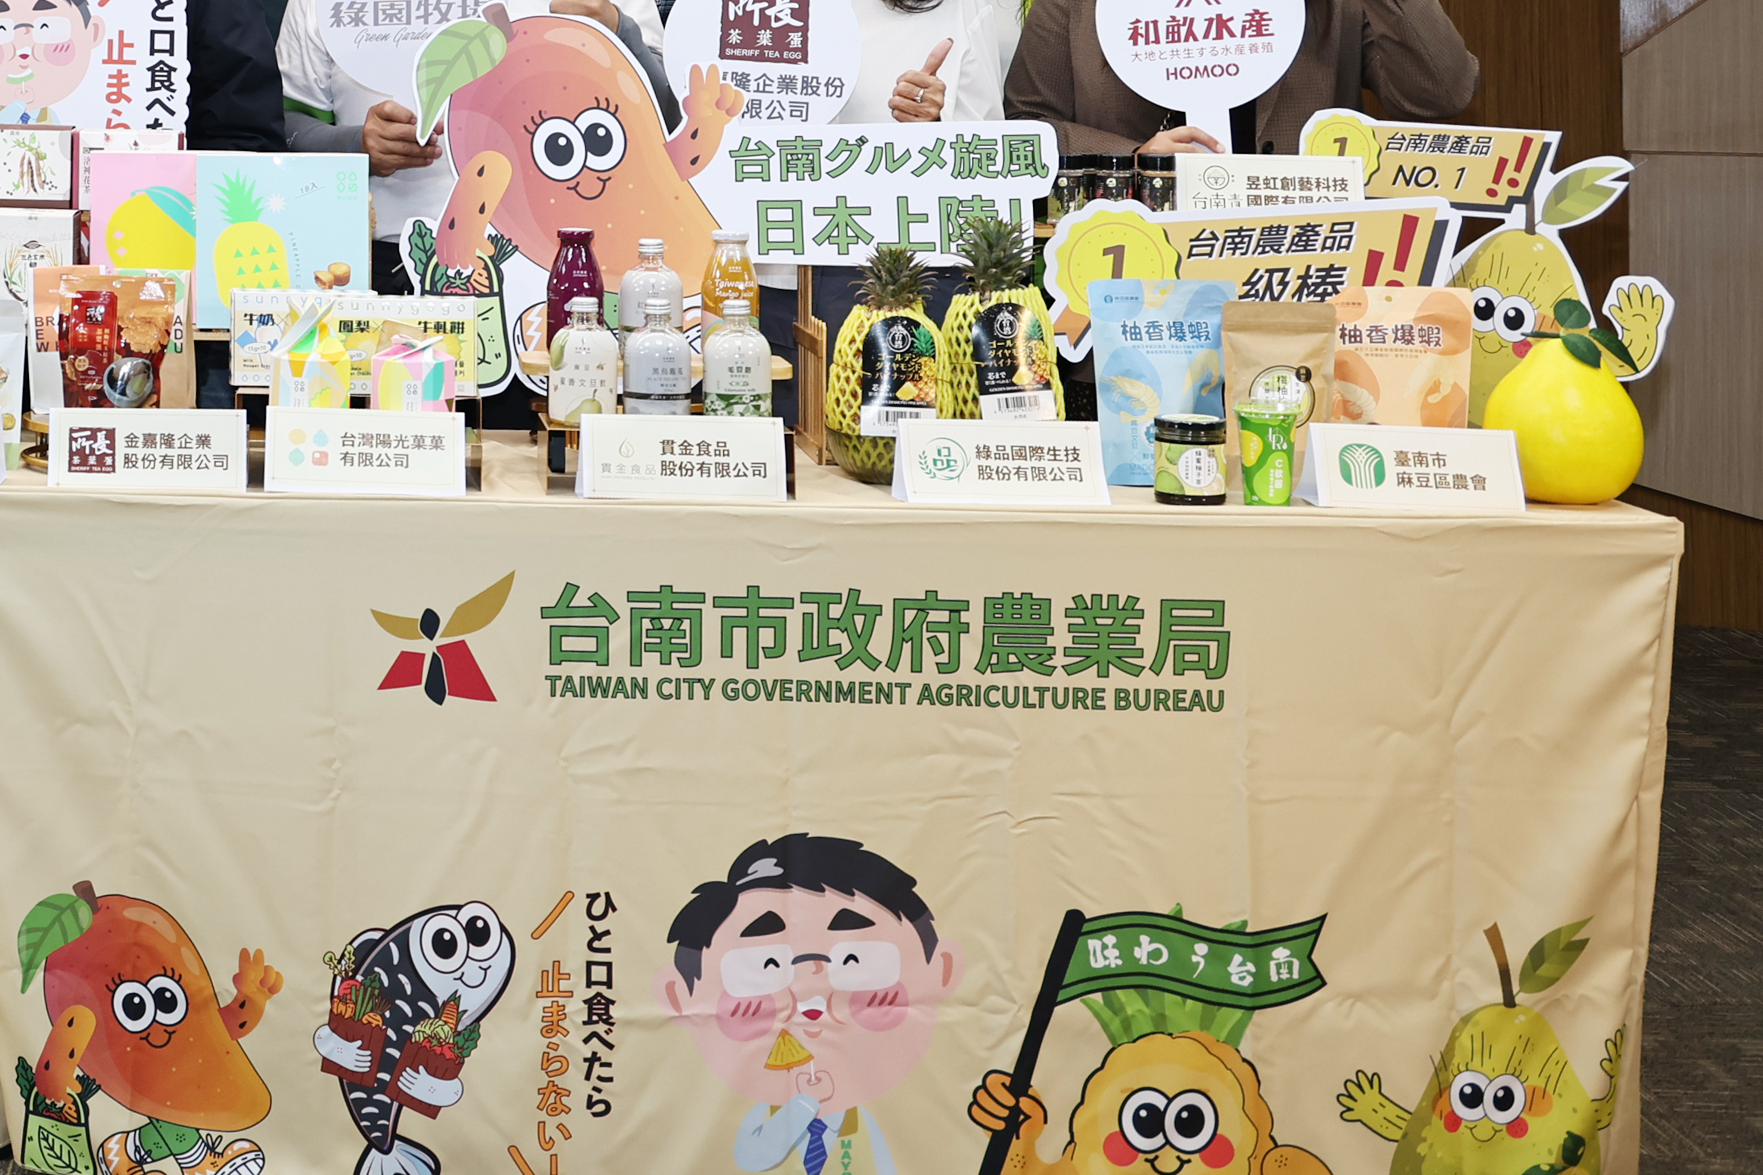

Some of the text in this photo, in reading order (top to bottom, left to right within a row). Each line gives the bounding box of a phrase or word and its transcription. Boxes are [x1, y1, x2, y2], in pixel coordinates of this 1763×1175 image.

[726, 28, 804, 49] 茶葉蛋
[725, 48, 802, 60] SHERIFF TEA EGG
[1166, 63, 1240, 81] HOMOO
[722, 70, 845, 99] 隆企業股份
[740, 98, 810, 123] 限公司
[728, 133, 1051, 183] 台南グルメ旋風
[1245, 176, 1349, 193] 昱虹創藝科技
[1392, 164, 1467, 191] NO. 1
[288, 232, 301, 278] PINEAPPLE
[1121, 320, 1212, 343] 柚香爆蝦
[1339, 323, 1444, 348] 柚香爆蝦
[123, 432, 212, 450] 金嘉隆企業
[340, 431, 446, 451] 台灣陽光菓菓
[659, 439, 731, 458] 貫金食品
[123, 453, 229, 471] 股份有限公司
[339, 451, 410, 469] 有限公司
[975, 444, 1082, 463] 綠品國際生技
[1393, 450, 1448, 469] 臺南市
[660, 460, 768, 479] 股份有限公司
[977, 465, 1084, 483] 股份有限公司
[1396, 472, 1489, 493] 麻豆區農會
[539, 582, 1232, 682] 台南市政府農業局
[546, 674, 1226, 713] TAIWAN CITY GOVERNMENT AGRICULTURE BUREAU
[1088, 932, 1302, 986] 味わう台南
[582, 890, 618, 1118] ひと口食べたら
[840, 1139, 853, 1175] MAY
